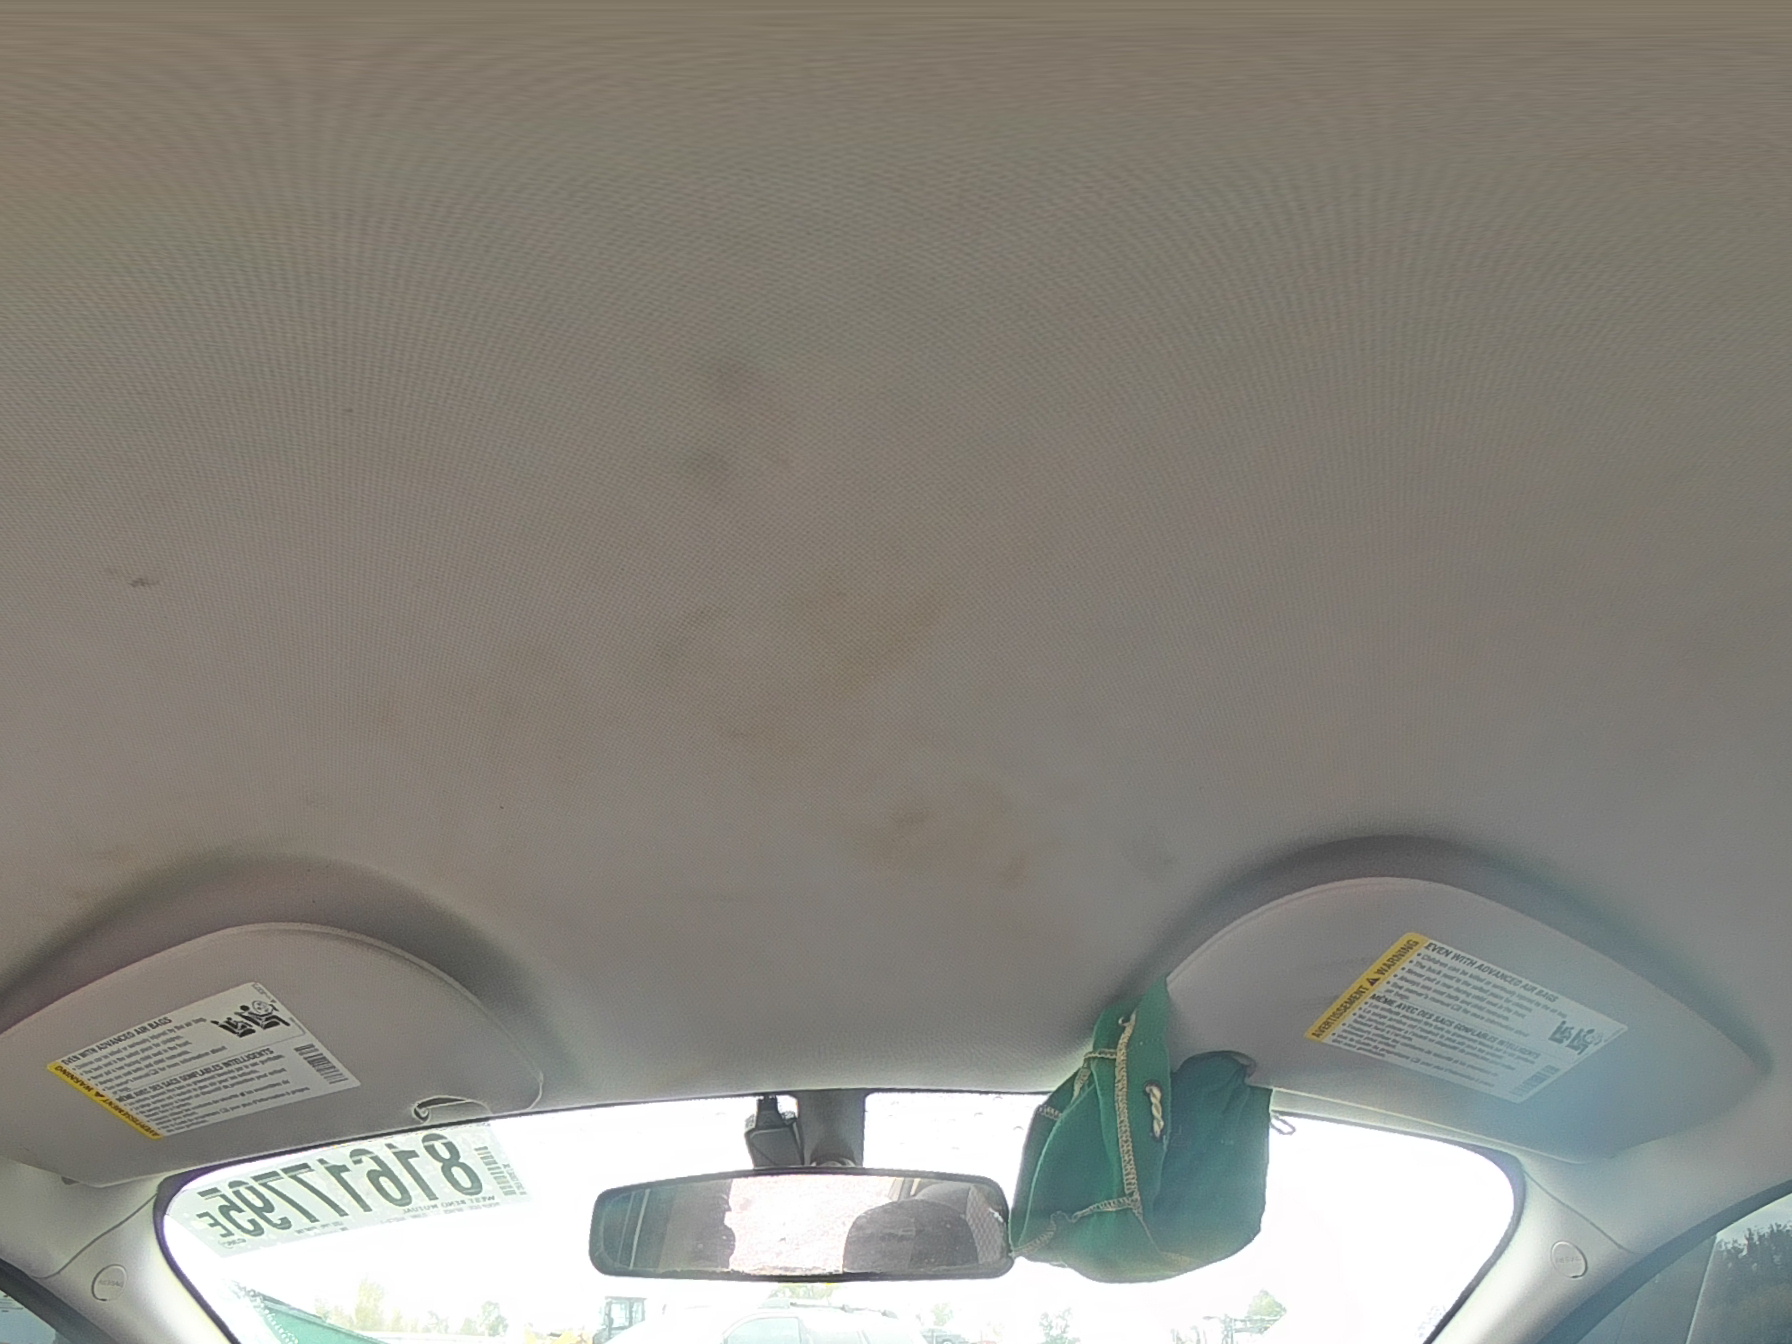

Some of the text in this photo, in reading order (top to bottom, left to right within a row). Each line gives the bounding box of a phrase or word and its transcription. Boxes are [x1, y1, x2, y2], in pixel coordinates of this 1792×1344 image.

[1375, 938, 1419, 976] WARNING
[1423, 941, 1453, 957] EVEN
[1450, 952, 1478, 967] WITH
[1474, 962, 1523, 987] ADVANCED
[1519, 982, 1537, 993] AIR
[1534, 988, 1559, 1003] BAGS
[1394, 1001, 1419, 1014] AVEC
[1415, 1009, 1435, 1019] DES
[1432, 1015, 1454, 1027] SACS
[96, 1032, 134, 1052] ADVANCED
[134, 1025, 148, 1036] AIR
[147, 1016, 172, 1030] BAGS
